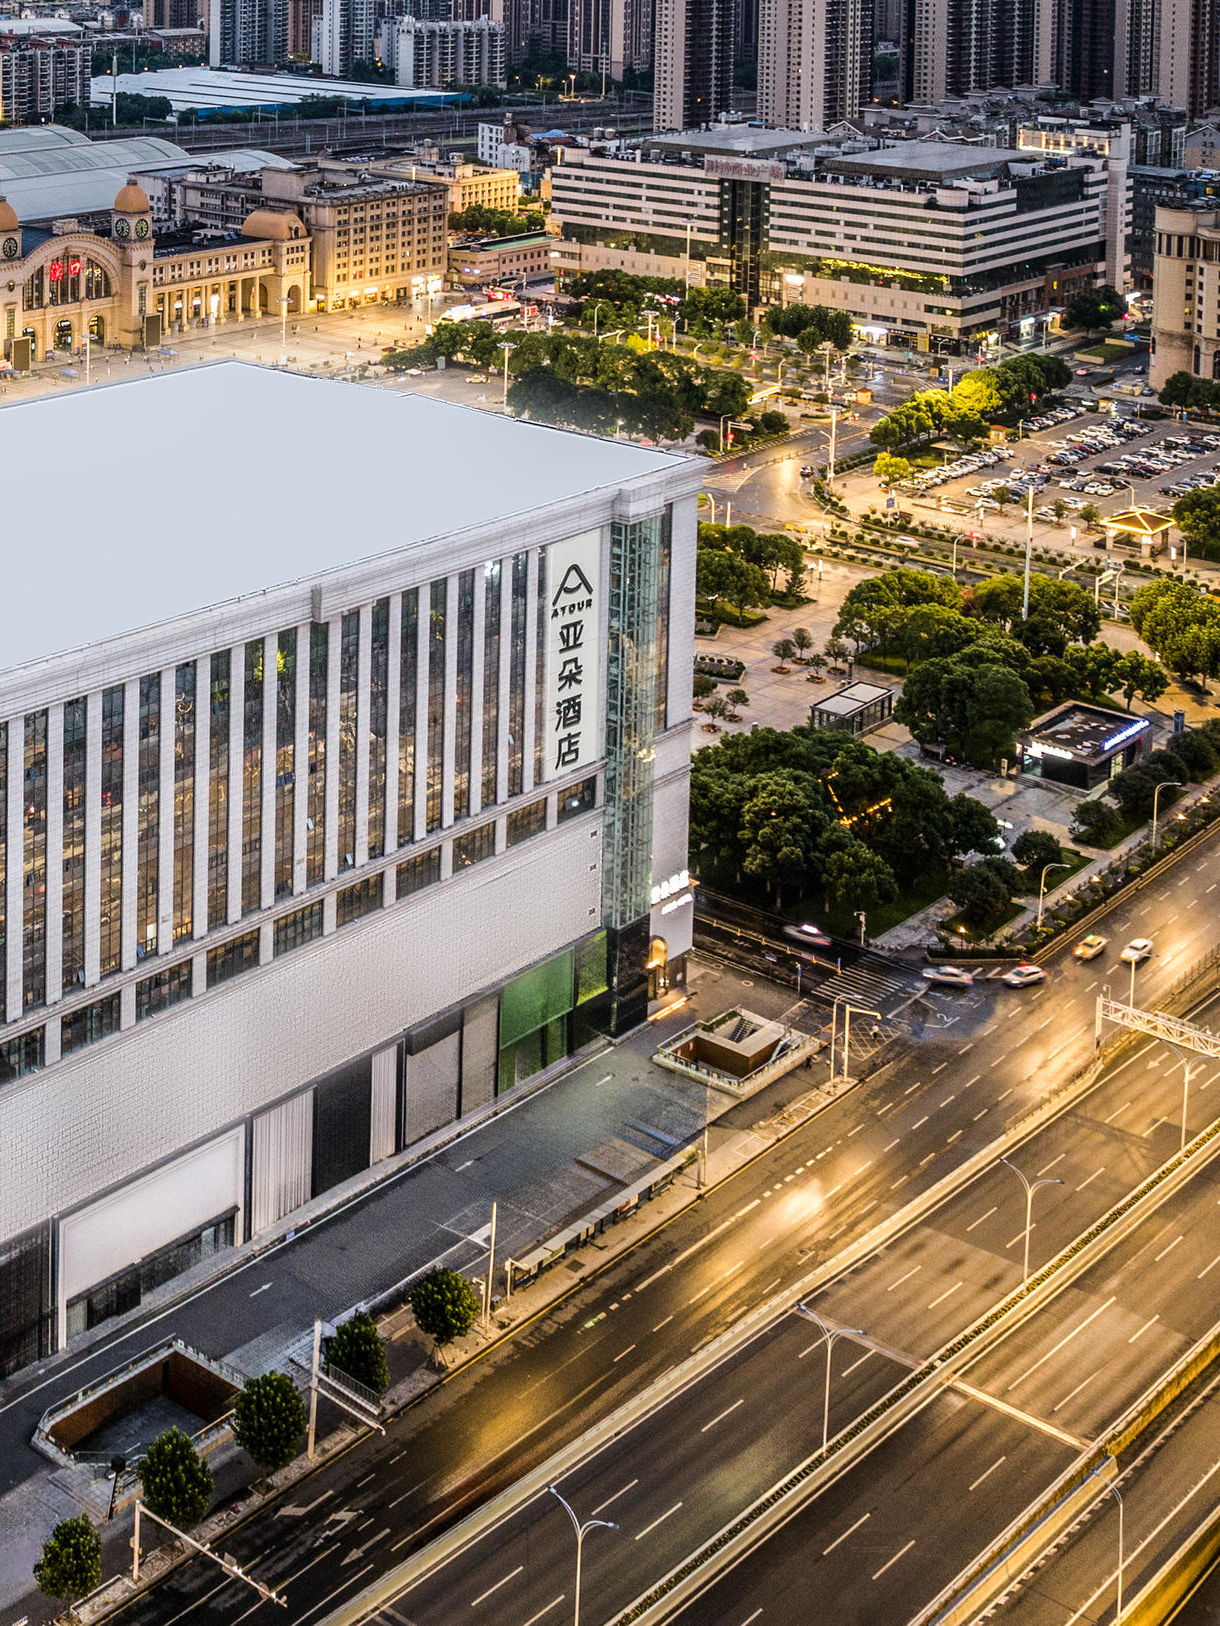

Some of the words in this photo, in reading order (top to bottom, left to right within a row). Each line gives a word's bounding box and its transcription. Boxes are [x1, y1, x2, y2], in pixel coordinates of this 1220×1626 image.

[551, 598, 593, 620] ATOUR
[555, 619, 584, 770] 亚朵酒店
